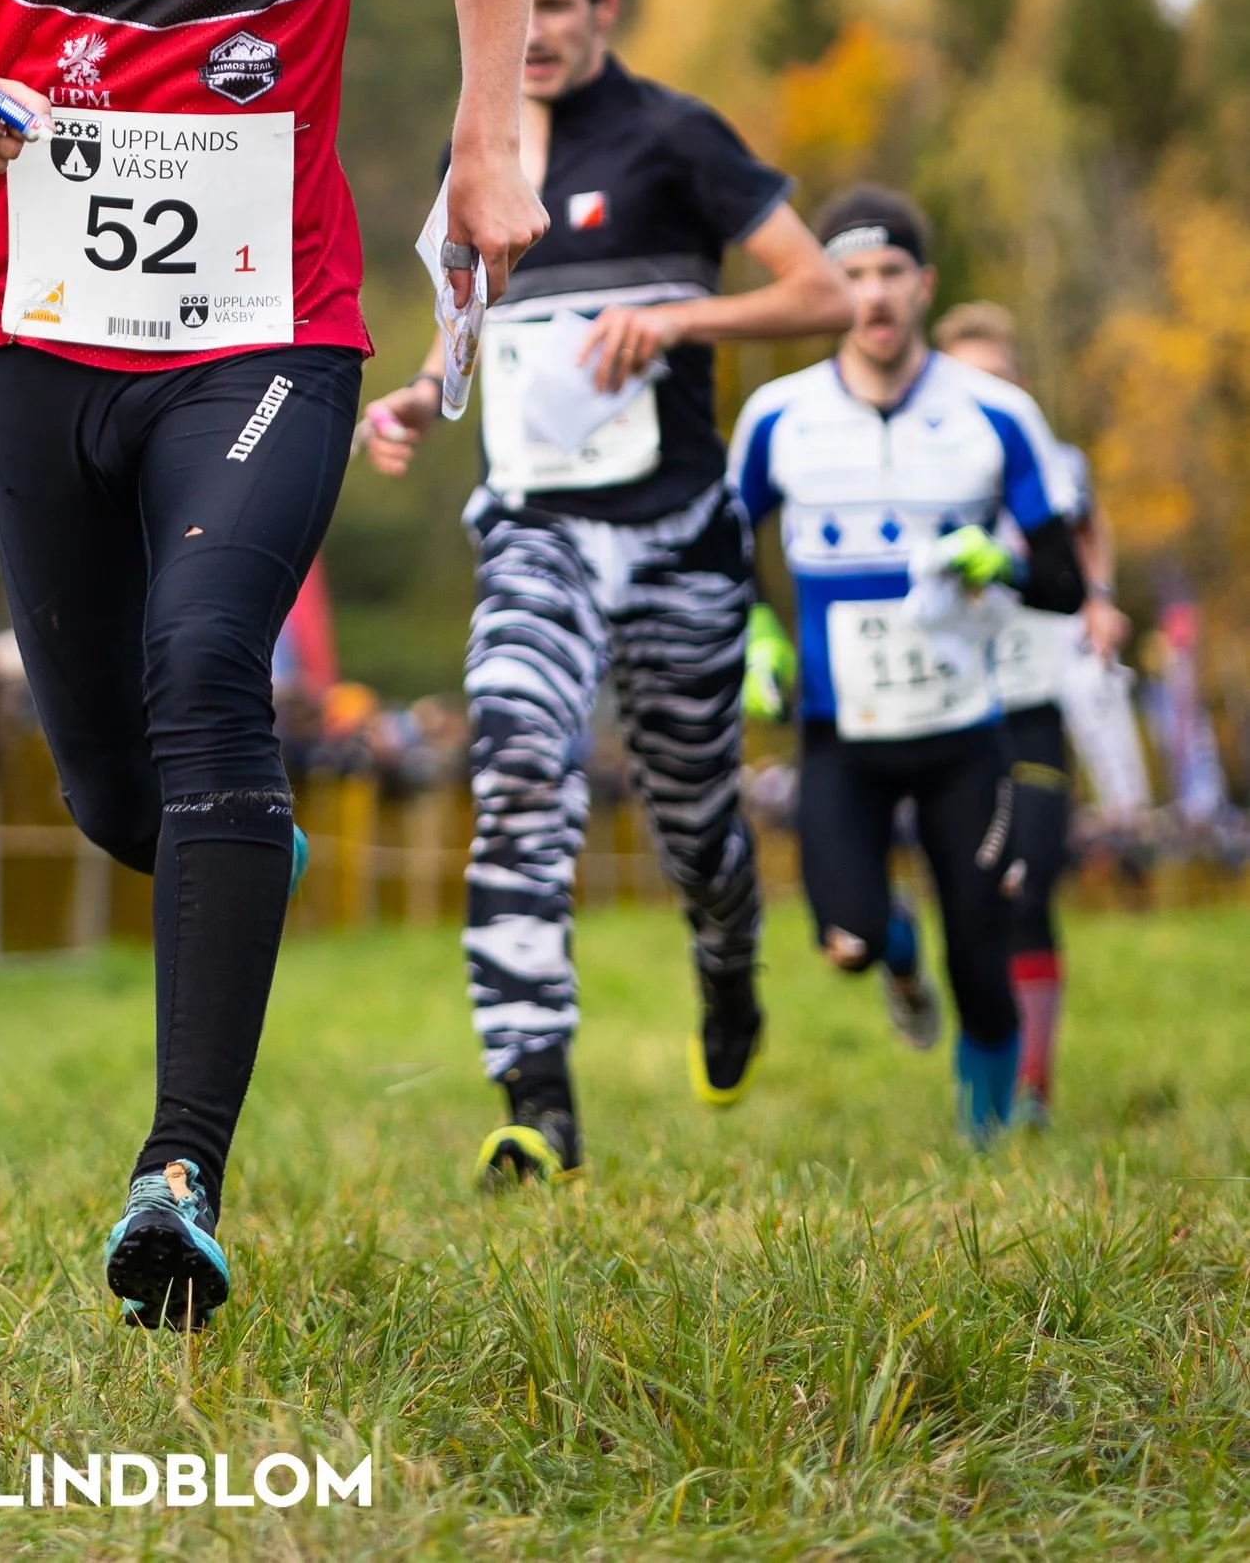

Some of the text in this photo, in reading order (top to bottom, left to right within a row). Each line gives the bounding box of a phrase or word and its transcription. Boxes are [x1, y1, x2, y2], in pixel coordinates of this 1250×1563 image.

[214, 61, 245, 73] HIMOS
[49, 87, 112, 107] UPM
[111, 128, 239, 152] UPPLANDS
[112, 153, 189, 180] VÄSBY
[84, 194, 199, 275] 52
[235, 245, 256, 273] 1
[213, 295, 282, 310] UPPLANDS
[214, 309, 255, 323] VÄSBY
